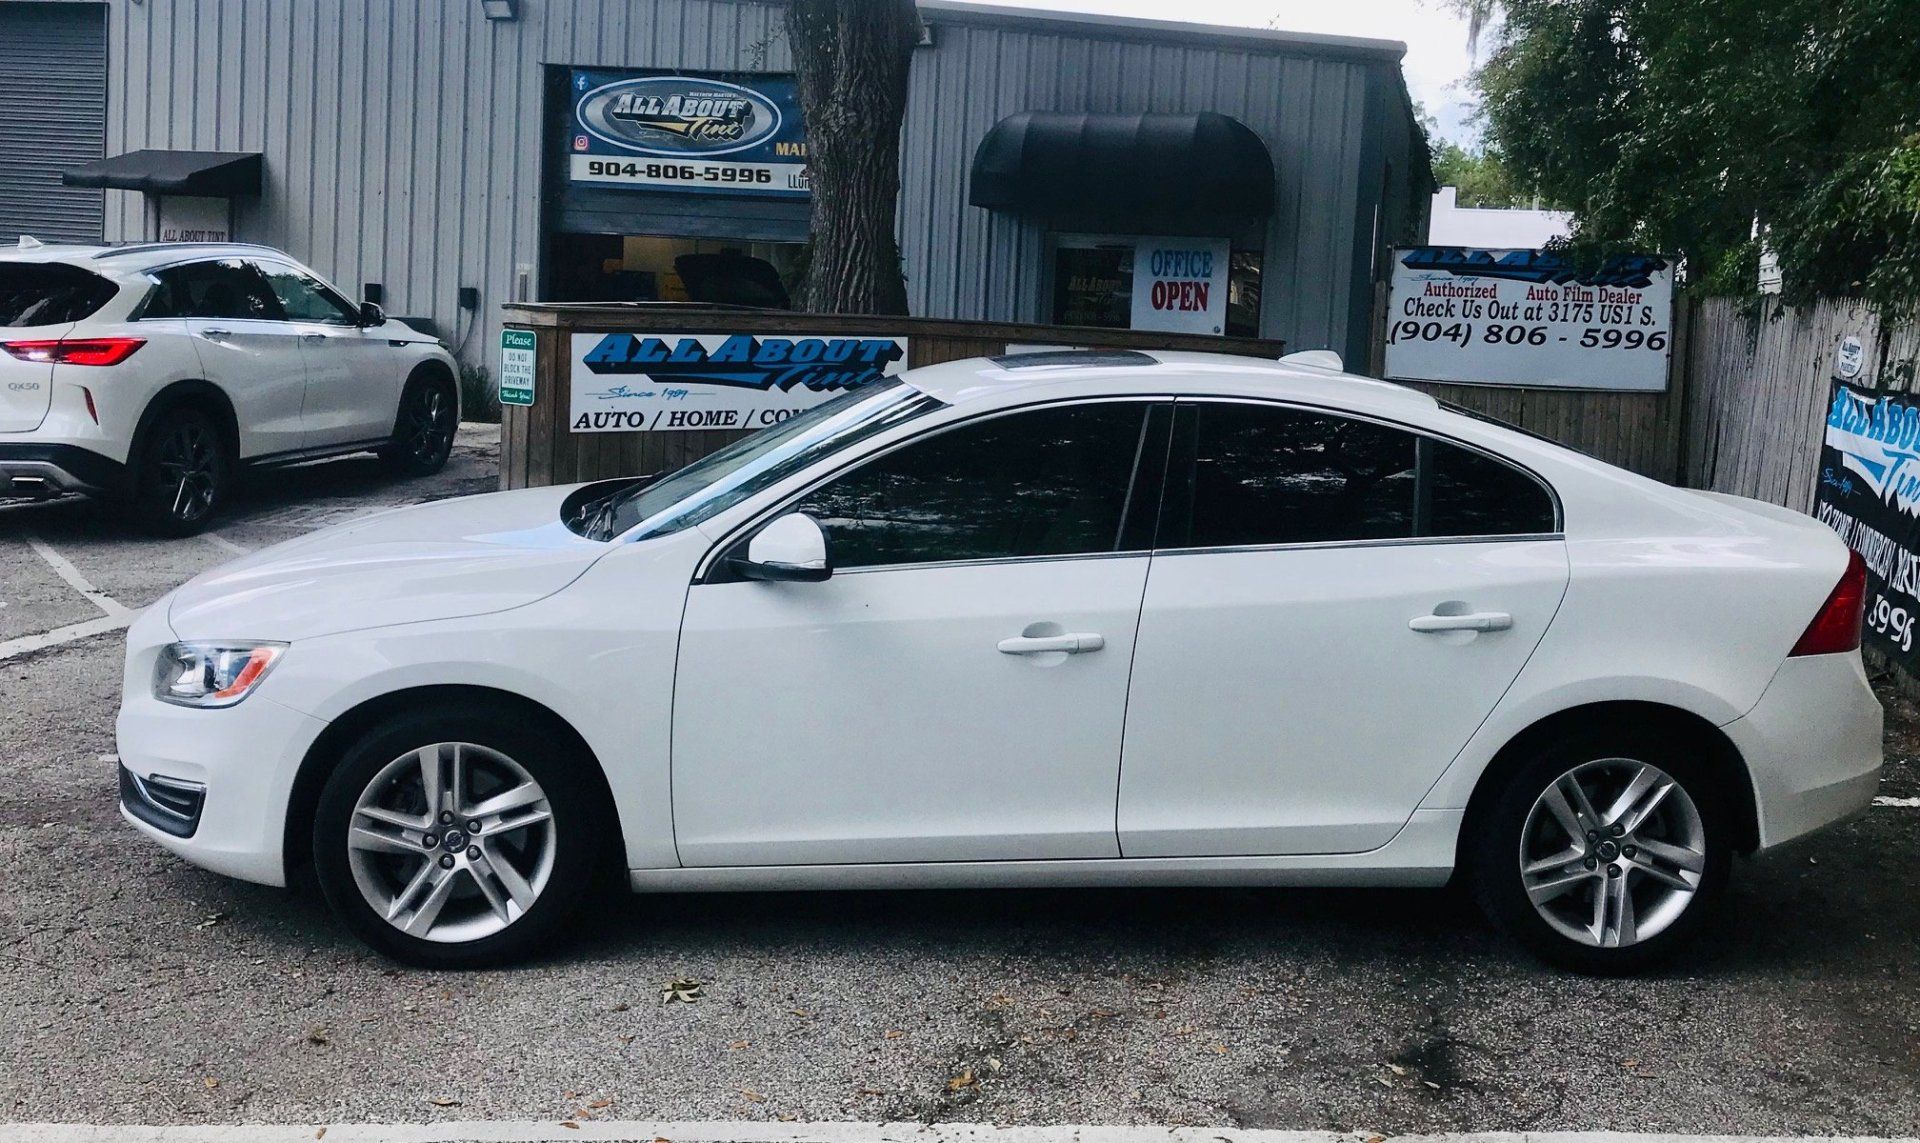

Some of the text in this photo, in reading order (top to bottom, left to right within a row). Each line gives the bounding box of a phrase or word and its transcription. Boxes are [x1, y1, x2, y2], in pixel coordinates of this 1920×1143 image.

[612, 93, 748, 118] ALL ABOUT
[682, 115, 740, 138] Tint
[588, 160, 772, 184] 904-806-5996
[163, 229, 177, 242] ALL
[1151, 250, 1213, 278] OFFICE
[1151, 281, 1210, 311] OPEN
[1423, 281, 1643, 305] Authorized Auto Film Dealer
[1404, 297, 1656, 326] Check Us Out at 3175 US1 S.
[506, 333, 532, 346] Please
[1391, 320, 1472, 348] (904)
[1484, 324, 1548, 346] 806
[1580, 328, 1668, 351] 5996
[583, 333, 900, 364] ALL ABOUT
[522, 365, 531, 375] THE
[756, 362, 882, 390] Tint
[598, 385, 656, 400] Since
[573, 410, 645, 429] AUTO
[650, 410, 663, 430] /
[667, 410, 739, 427] HOME
[742, 409, 755, 428] /
